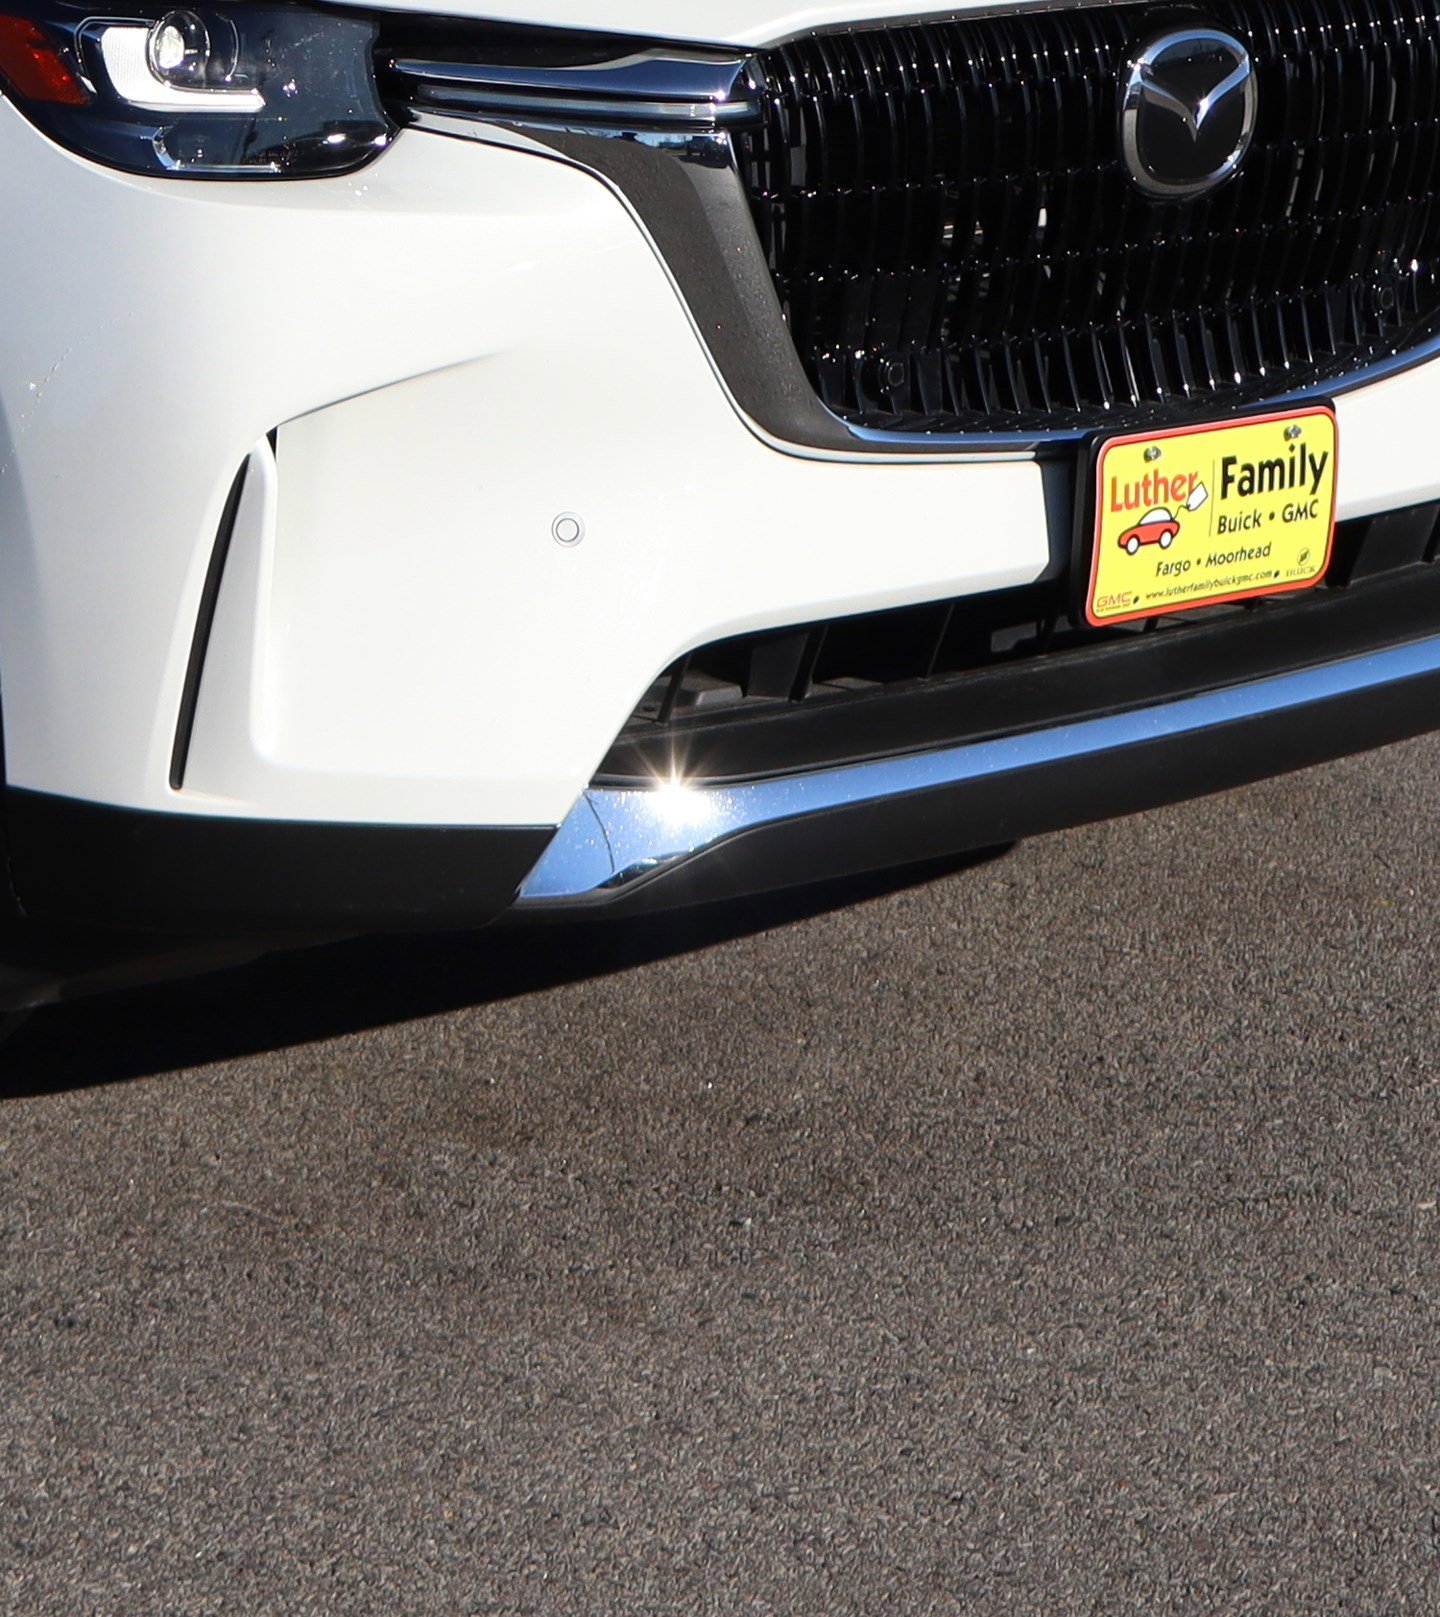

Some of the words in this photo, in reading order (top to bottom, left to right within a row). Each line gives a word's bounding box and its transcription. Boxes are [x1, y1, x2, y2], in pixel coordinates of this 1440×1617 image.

[1110, 468, 1199, 513] Luther
[1221, 442, 1329, 500] Family
[1217, 509, 1262, 535] Buick
[1282, 499, 1319, 524] GMC
[1155, 559, 1191, 577] Fargo
[1205, 542, 1272, 568] Moorhead
[1096, 591, 1133, 609] GMC
